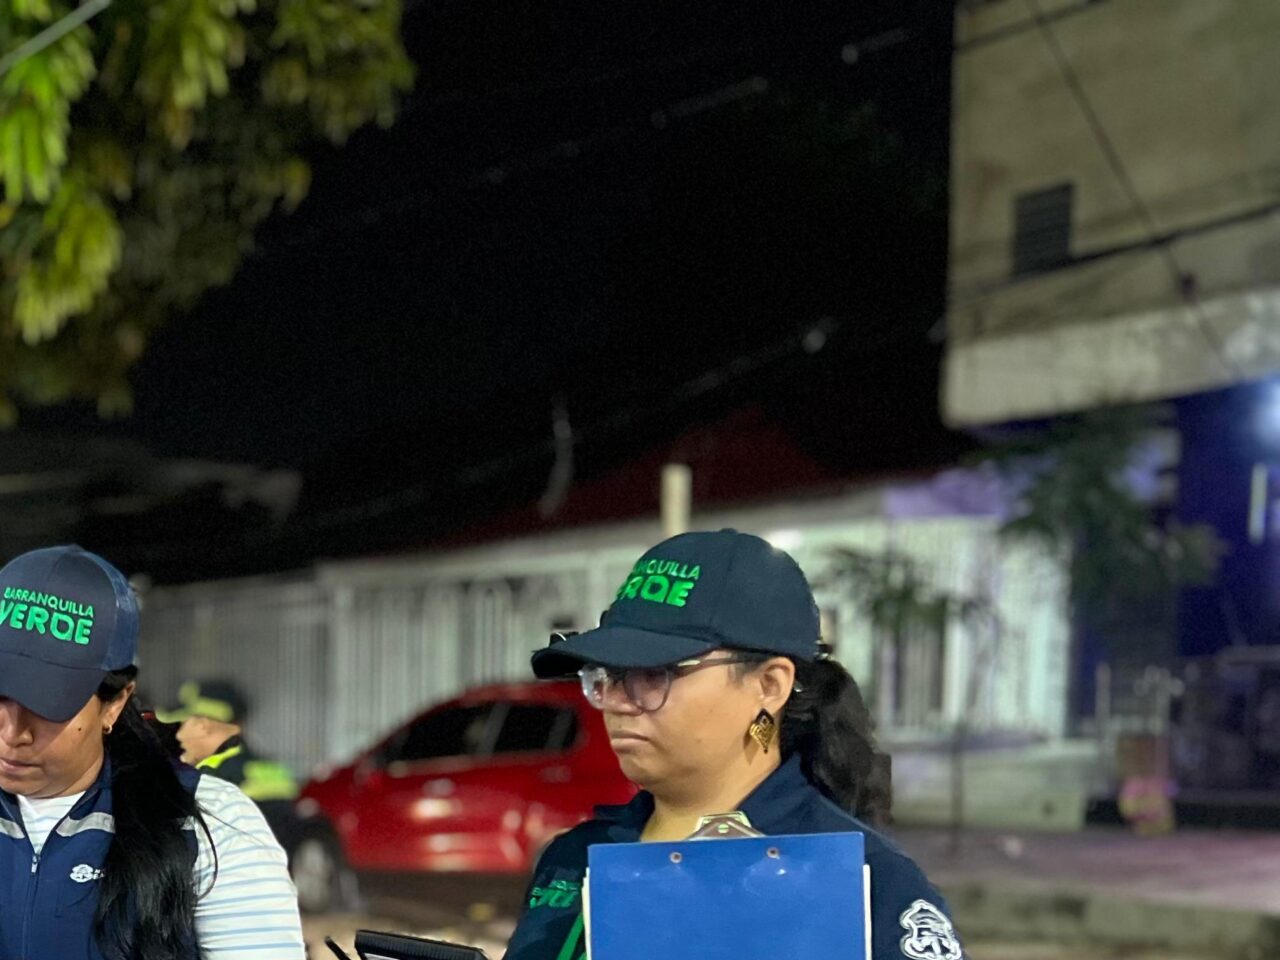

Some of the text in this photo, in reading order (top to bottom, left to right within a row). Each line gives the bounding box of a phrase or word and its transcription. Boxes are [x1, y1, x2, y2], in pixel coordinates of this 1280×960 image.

[634, 559, 700, 581] NQUILLA
[3, 586, 94, 618] BARRANQUILLA
[619, 575, 694, 607] RDE
